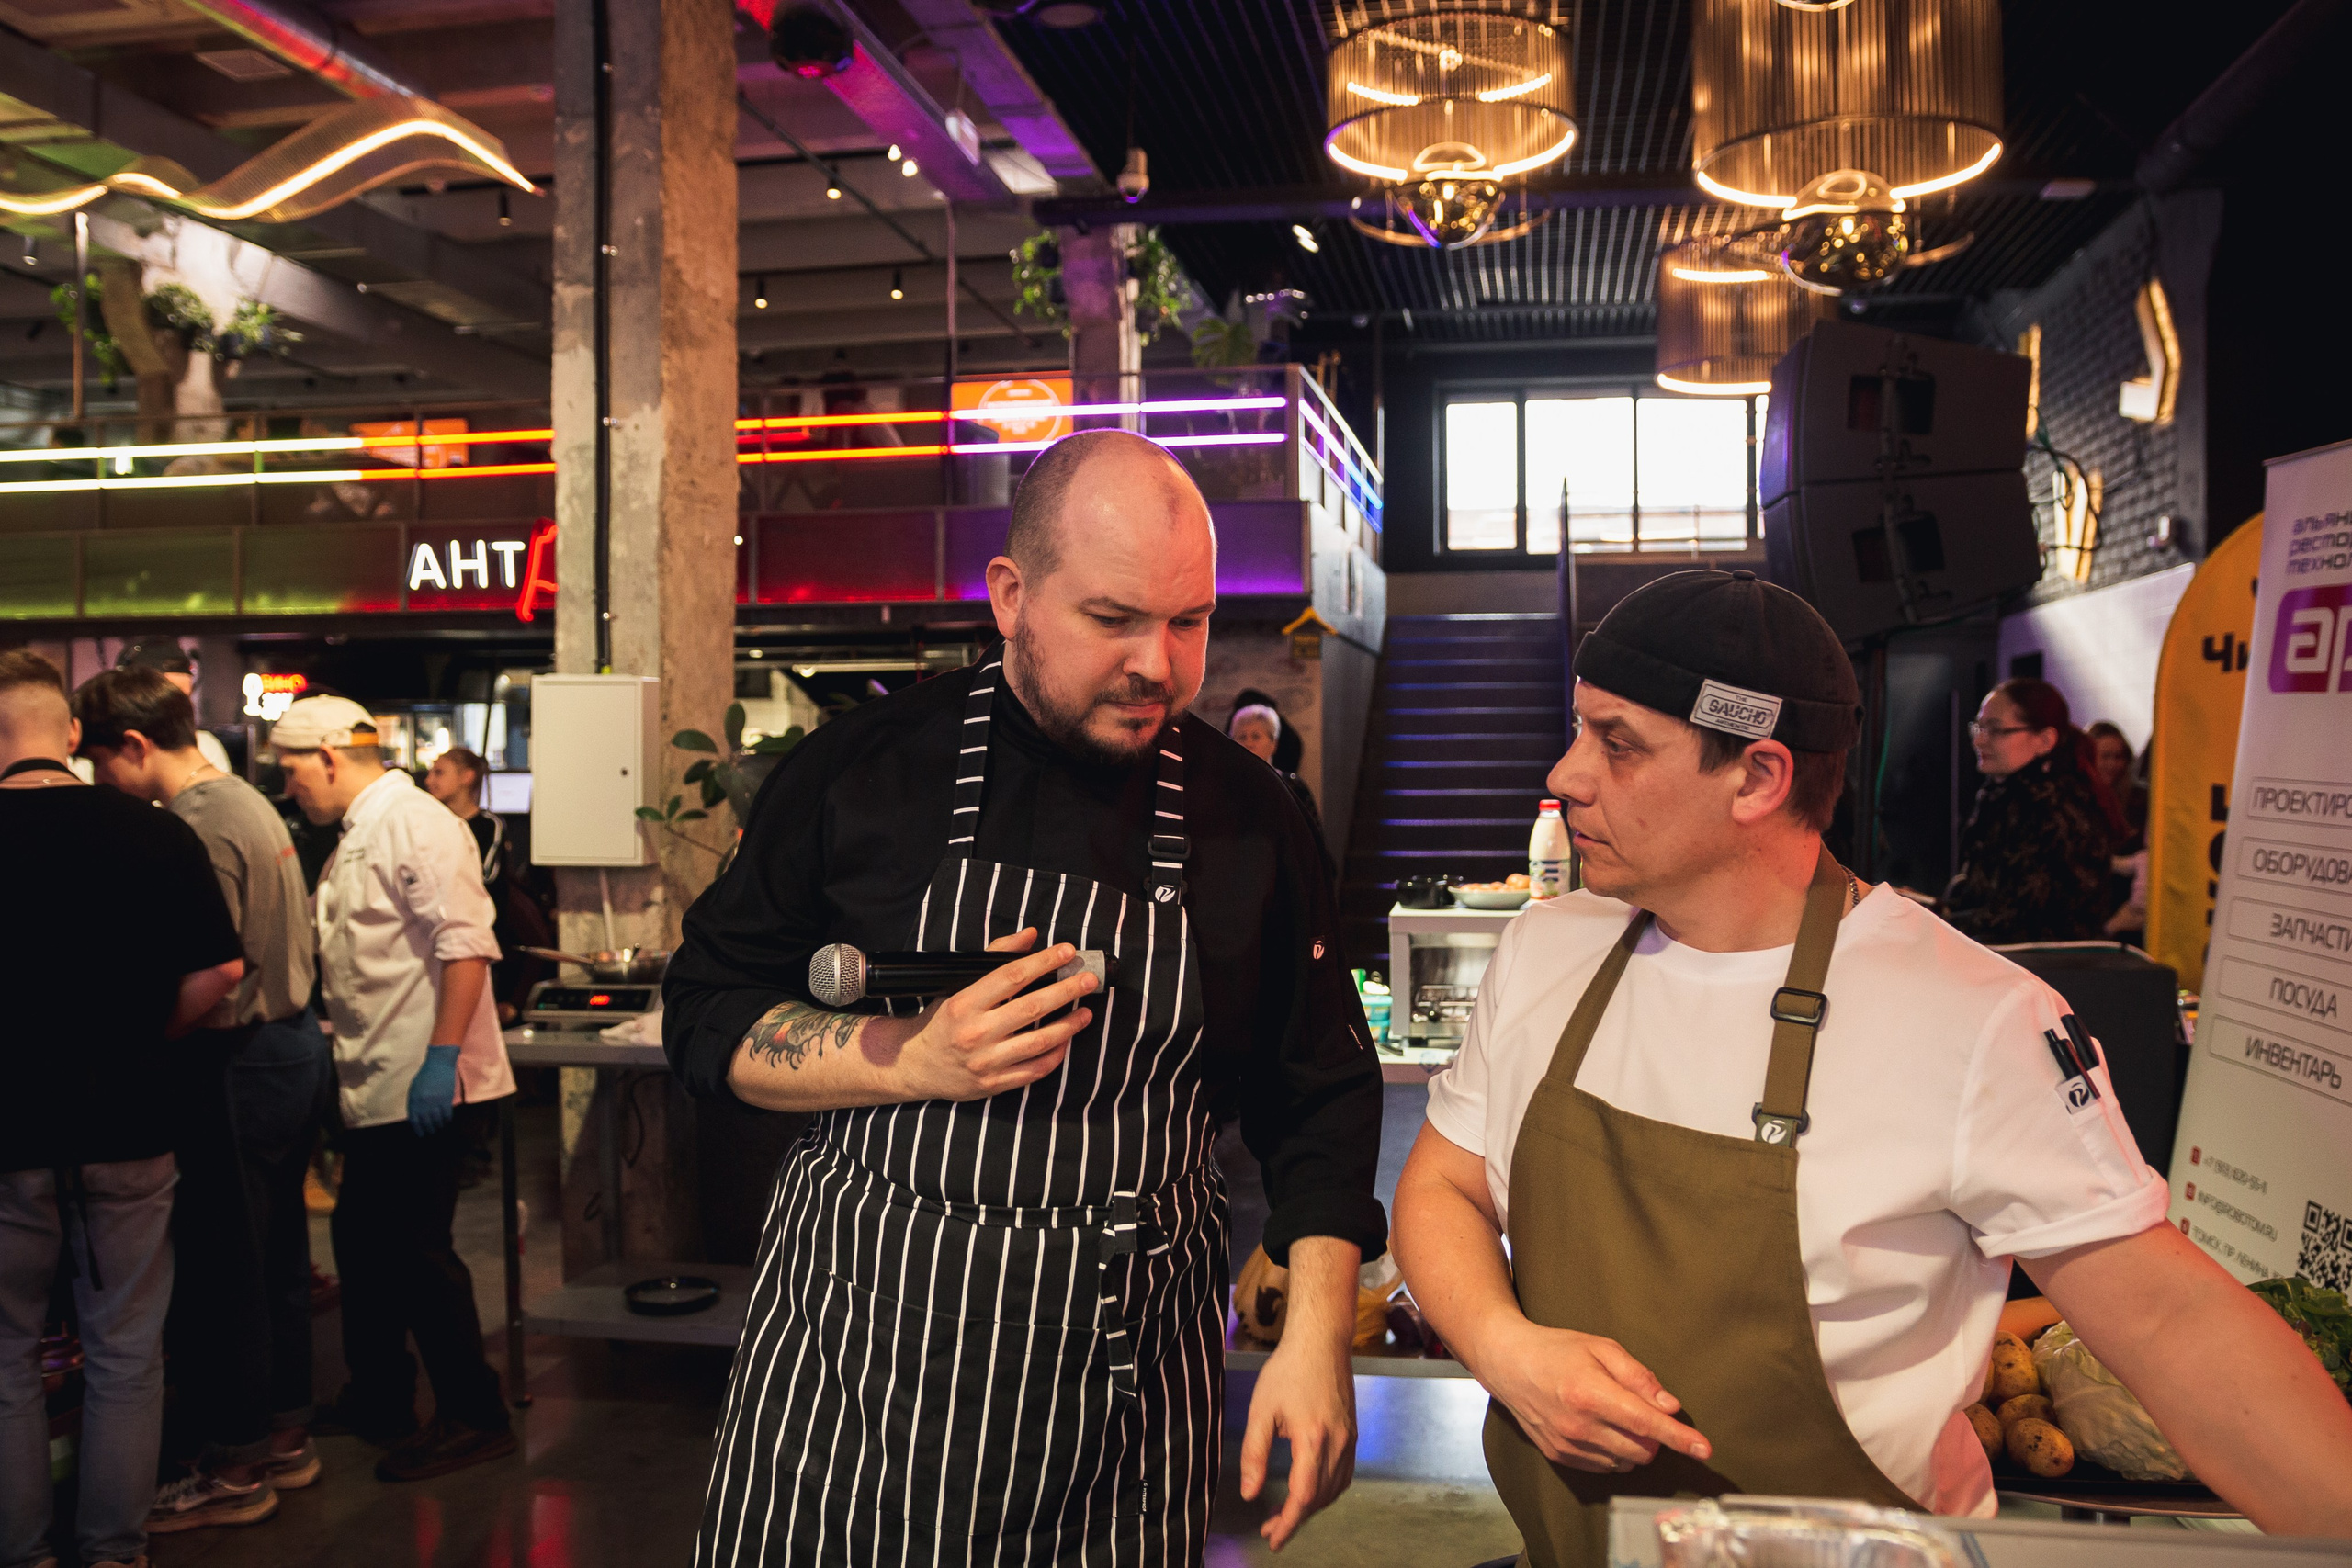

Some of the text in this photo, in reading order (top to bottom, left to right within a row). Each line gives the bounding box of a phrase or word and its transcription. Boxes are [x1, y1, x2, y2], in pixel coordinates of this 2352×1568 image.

[1709, 699, 1766, 724] GAUCHO
[2268, 977, 2337, 1020] ПОСУДА
[2245, 1035, 2342, 1090] ИНВЕНТАРЬ
